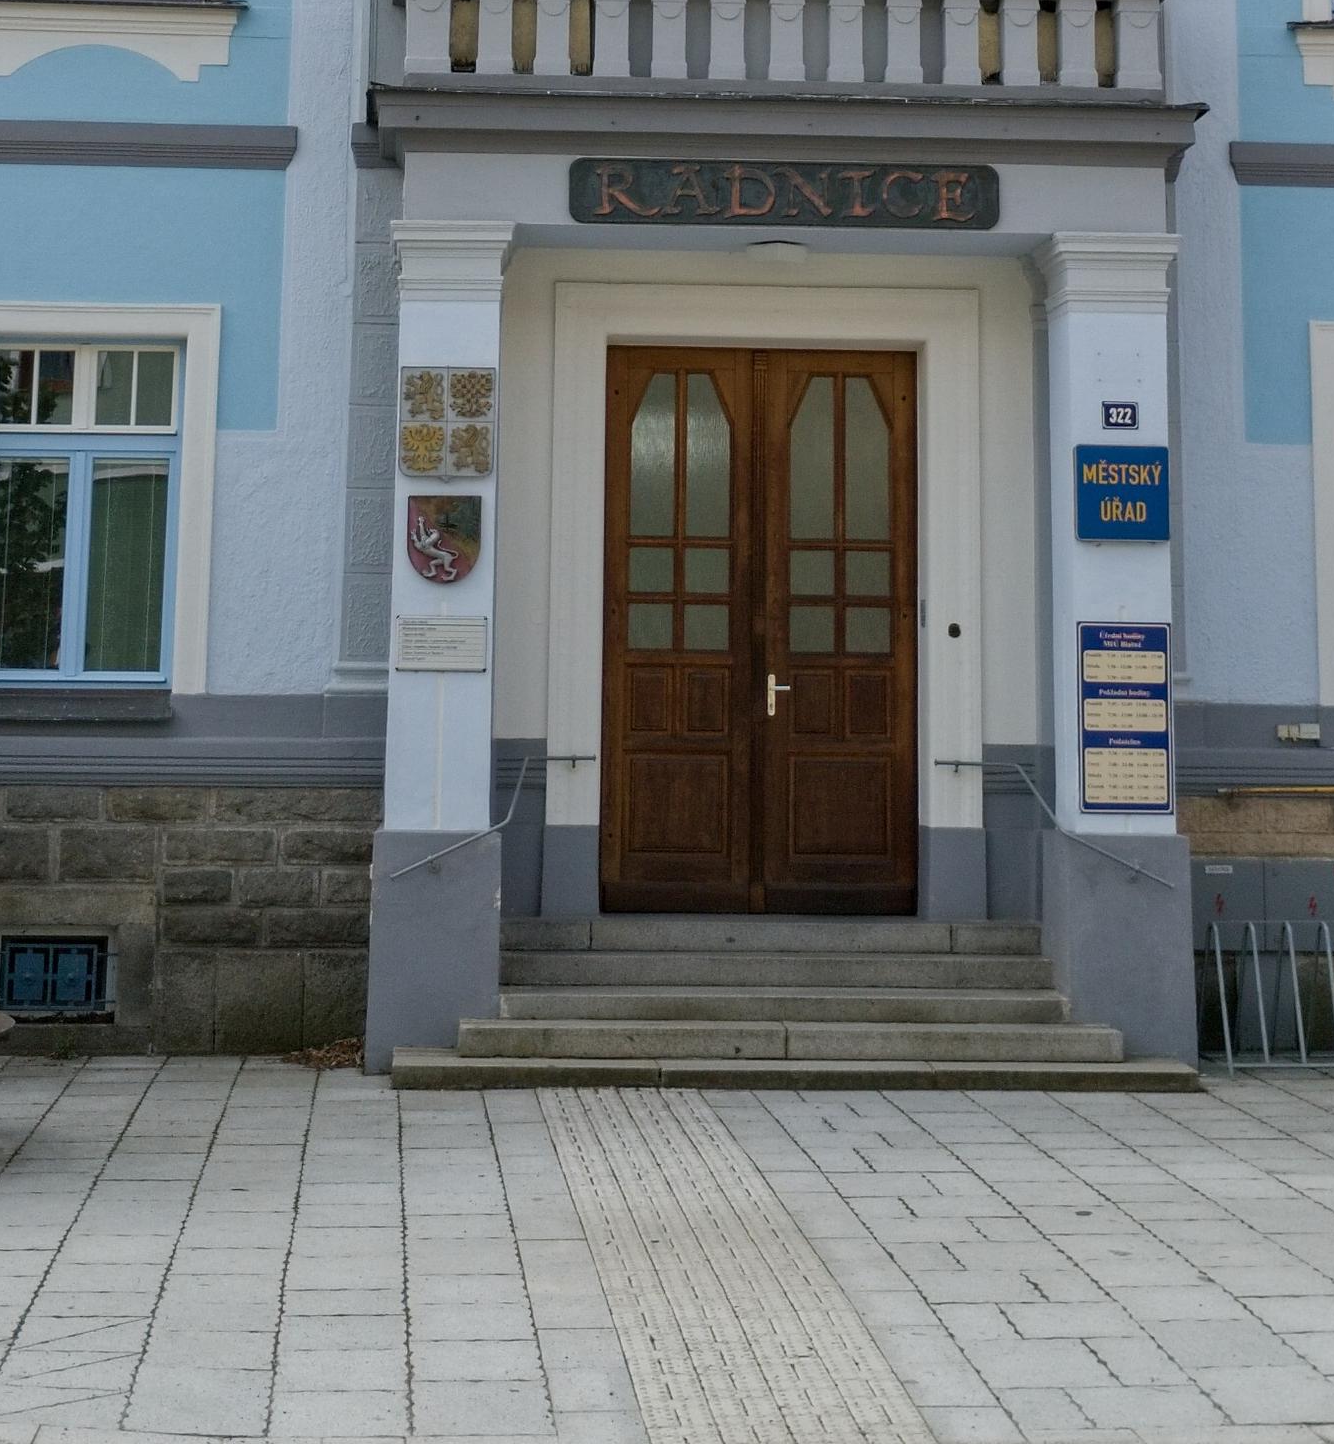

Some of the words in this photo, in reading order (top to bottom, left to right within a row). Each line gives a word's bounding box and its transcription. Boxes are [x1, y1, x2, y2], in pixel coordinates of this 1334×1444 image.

[594, 164, 976, 223] RADNICE
[1109, 407, 1132, 424] 322
[1083, 459, 1162, 486] MĚSTSKÝ
[1100, 496, 1147, 522] ÚŘAD
